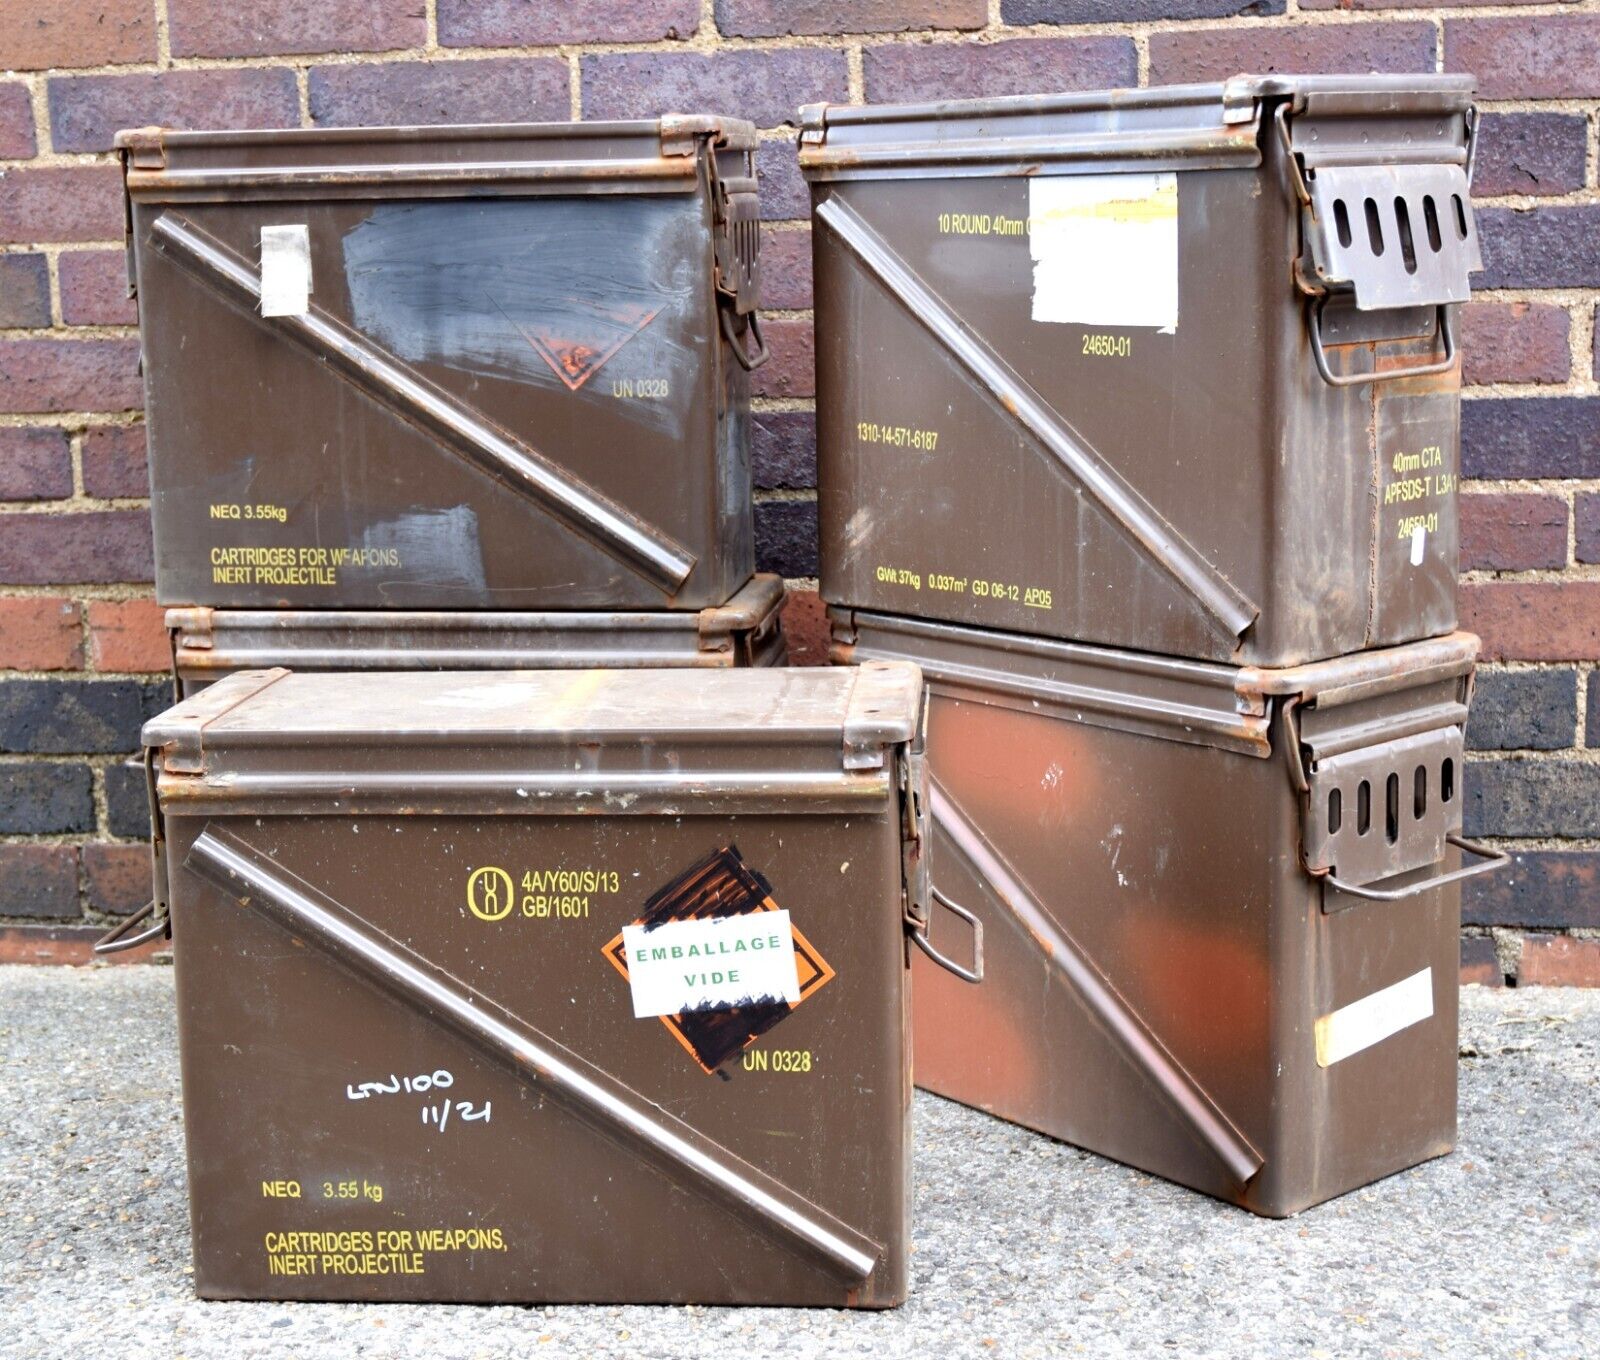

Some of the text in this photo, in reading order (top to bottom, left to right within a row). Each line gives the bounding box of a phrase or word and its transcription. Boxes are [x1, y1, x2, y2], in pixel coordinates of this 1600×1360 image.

[938, 214, 949, 233] 10
[952, 215, 990, 235] ROUND
[993, 217, 1023, 236] 40mm
[1083, 335, 1131, 357] 24650-01
[613, 379, 669, 397] UN 0328
[857, 422, 938, 450] 1310-14-571-6187
[1393, 446, 1442, 473] 40mm CTA
[1384, 476, 1431, 505] APFSDS-T
[210, 505, 287, 522] NEQ 3.55kg
[211, 547, 296, 566] CARTRIDGES
[299, 548, 327, 566] FOR
[213, 567, 336, 585] INERT PROJECTILE
[899, 570, 921, 590] 37kg
[972, 580, 989, 596] GD
[992, 583, 1019, 601] 06-12
[1024, 588, 1052, 609] AP05
[521, 871, 620, 893] 4A/Y60/S/13
[522, 896, 590, 918] GB/1601
[636, 936, 781, 962] EMBALLAGE
[684, 970, 741, 987] VIDE
[743, 1050, 811, 1072] UN 0328
[422, 1098, 491, 1132] 11/21
[262, 1180, 383, 1202] NEQ 3.55 kg
[265, 1229, 508, 1253] CARTRIDGES FOR WEAPONS,
[269, 1253, 425, 1275] INERT PROJECTILE
